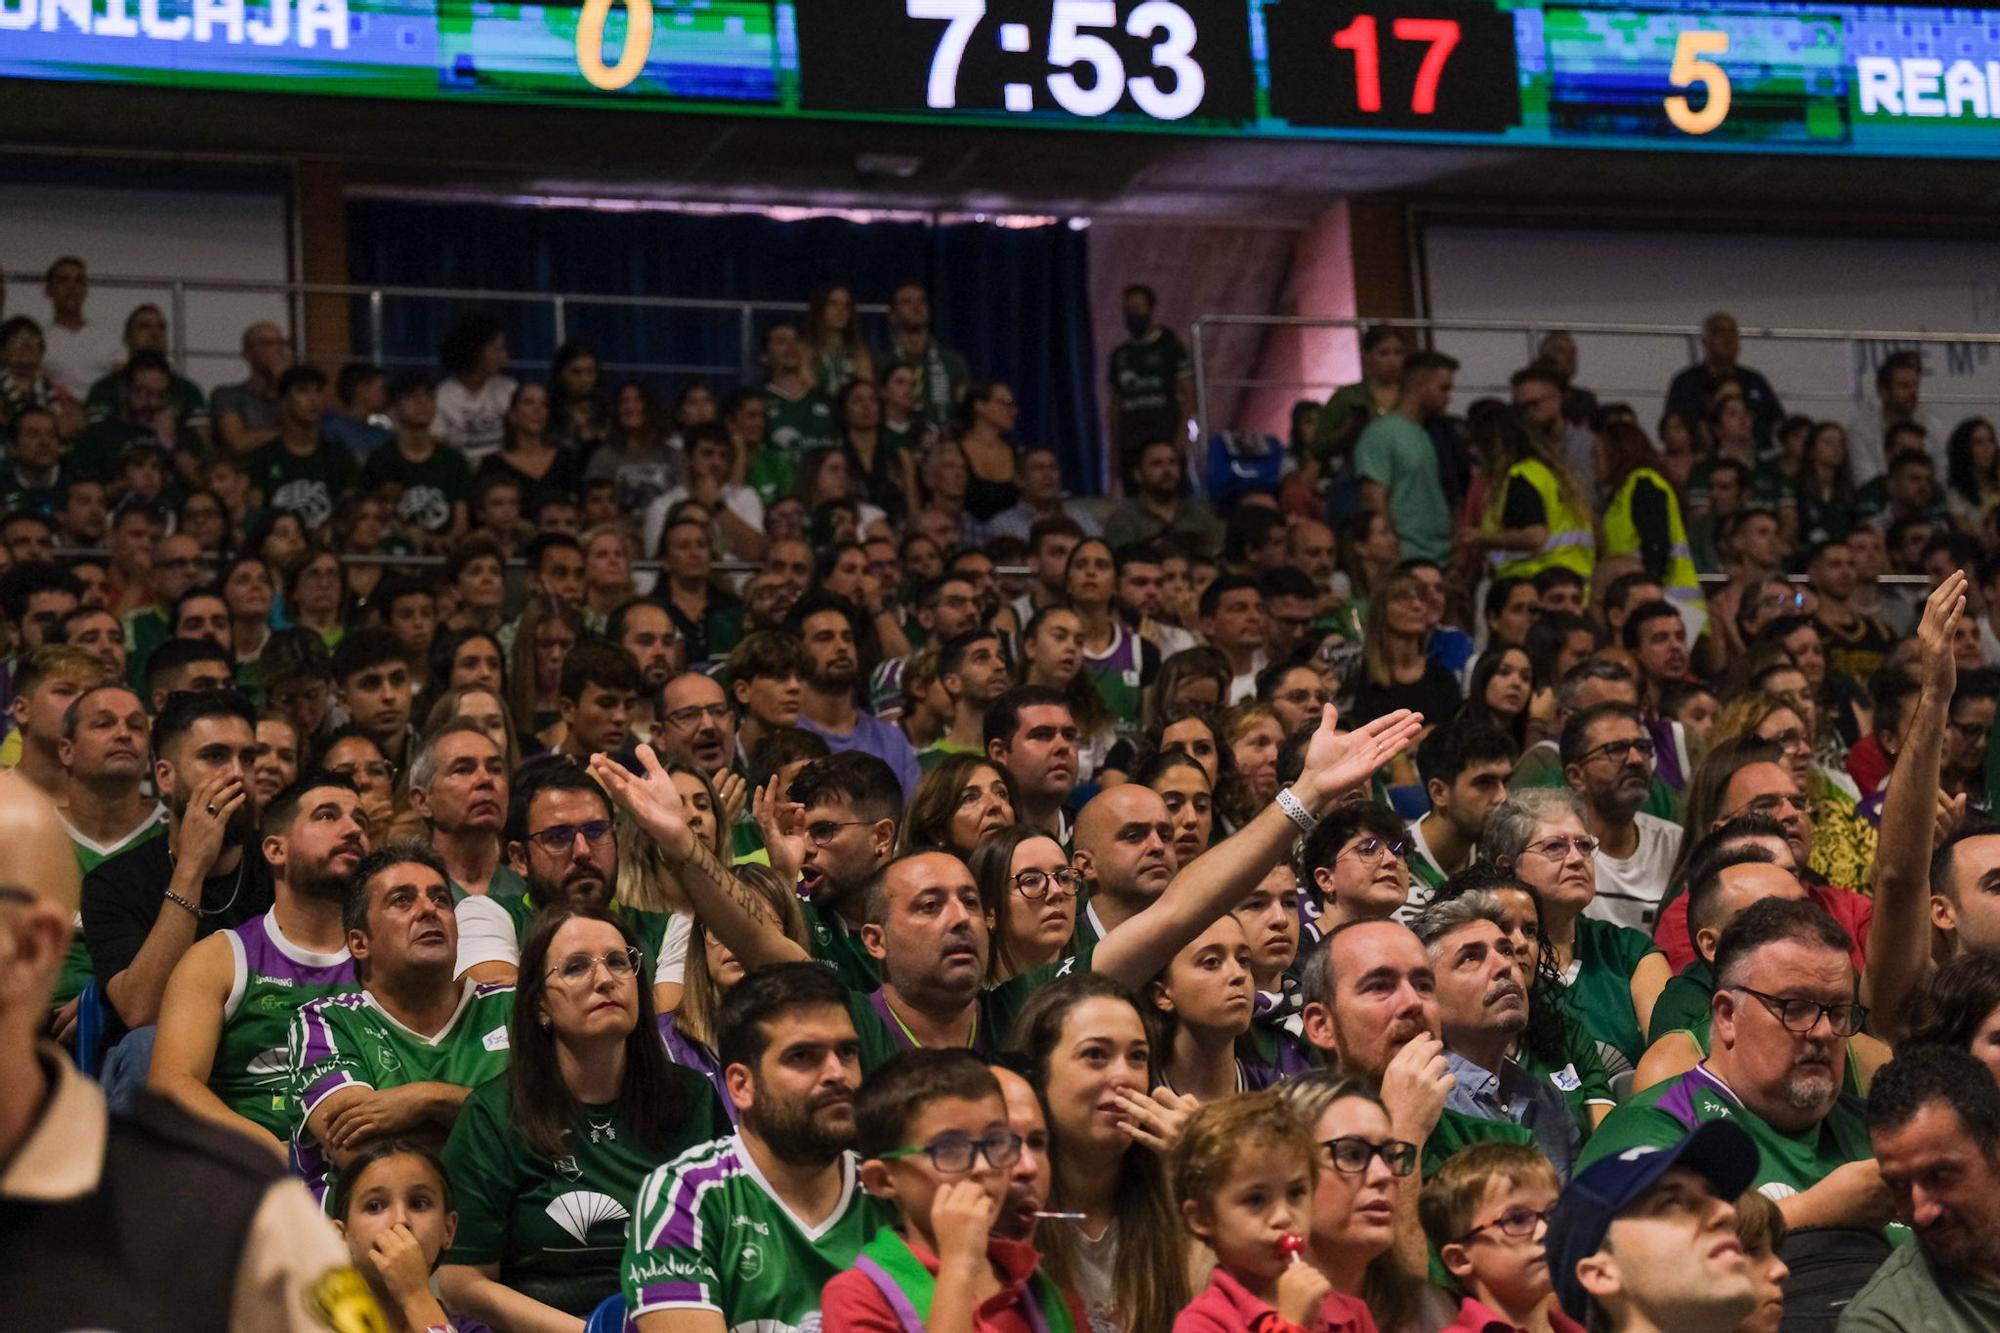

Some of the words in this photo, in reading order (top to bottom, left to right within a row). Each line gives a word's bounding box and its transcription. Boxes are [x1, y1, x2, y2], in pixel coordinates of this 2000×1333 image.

[576, 0, 653, 90] 0
[906, 0, 1205, 120] 7:53
[1333, 15, 1461, 115] 17
[1664, 31, 1732, 135] 5
[628, 1252, 721, 1285] Andalucía
